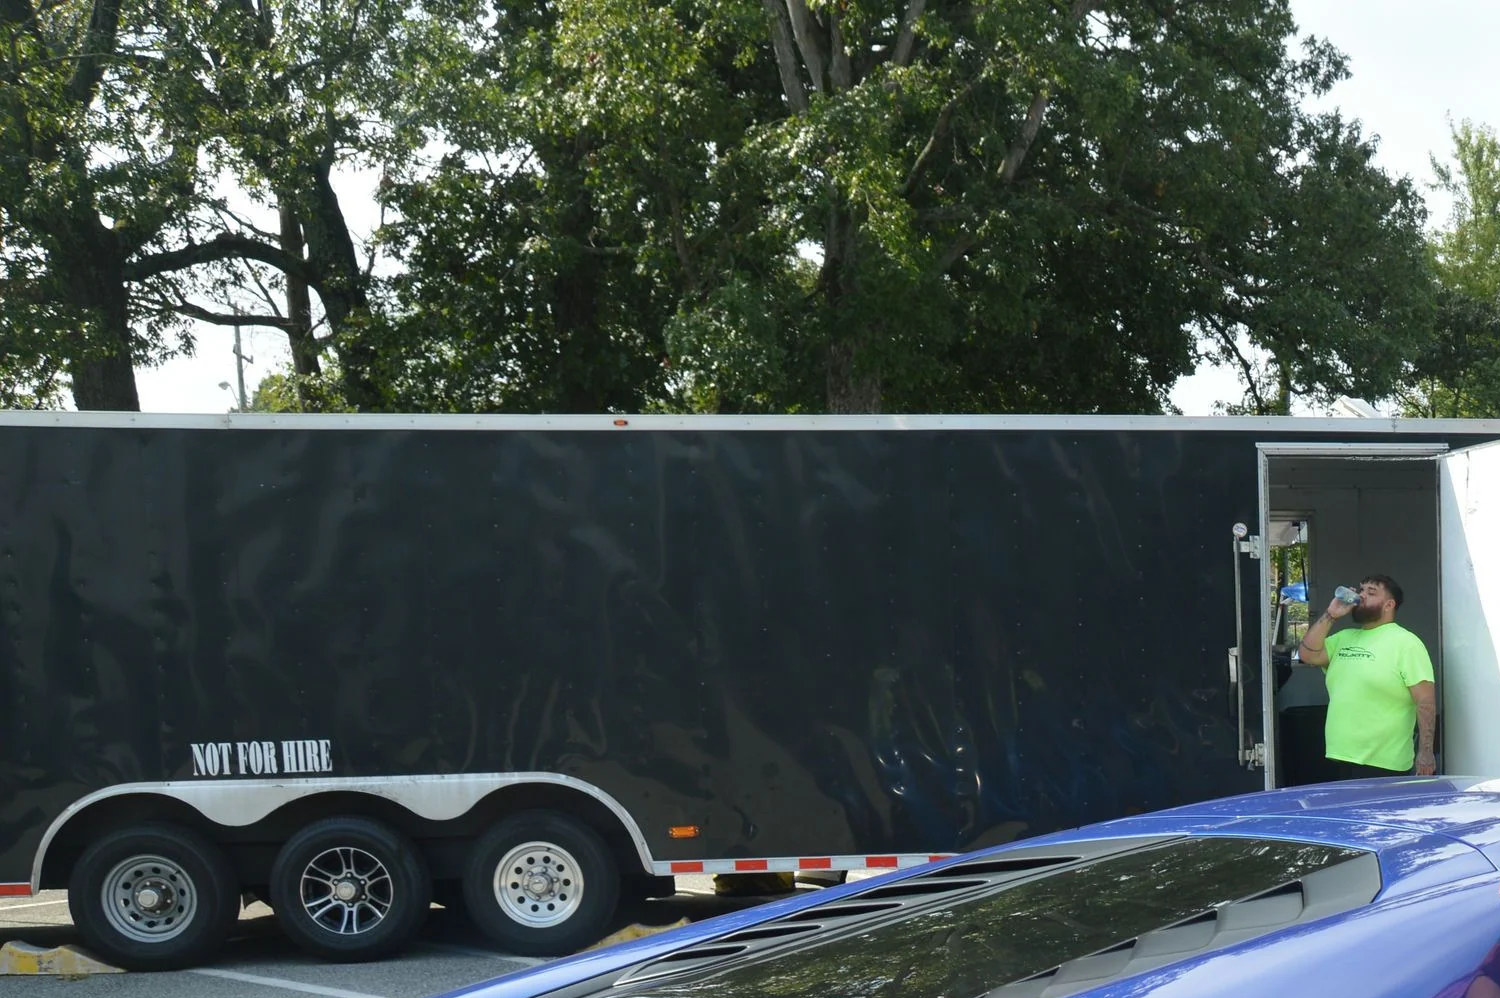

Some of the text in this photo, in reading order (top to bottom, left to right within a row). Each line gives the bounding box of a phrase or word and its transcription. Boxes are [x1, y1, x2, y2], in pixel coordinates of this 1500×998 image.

[190, 739, 333, 776] NOT FOR HIRE
